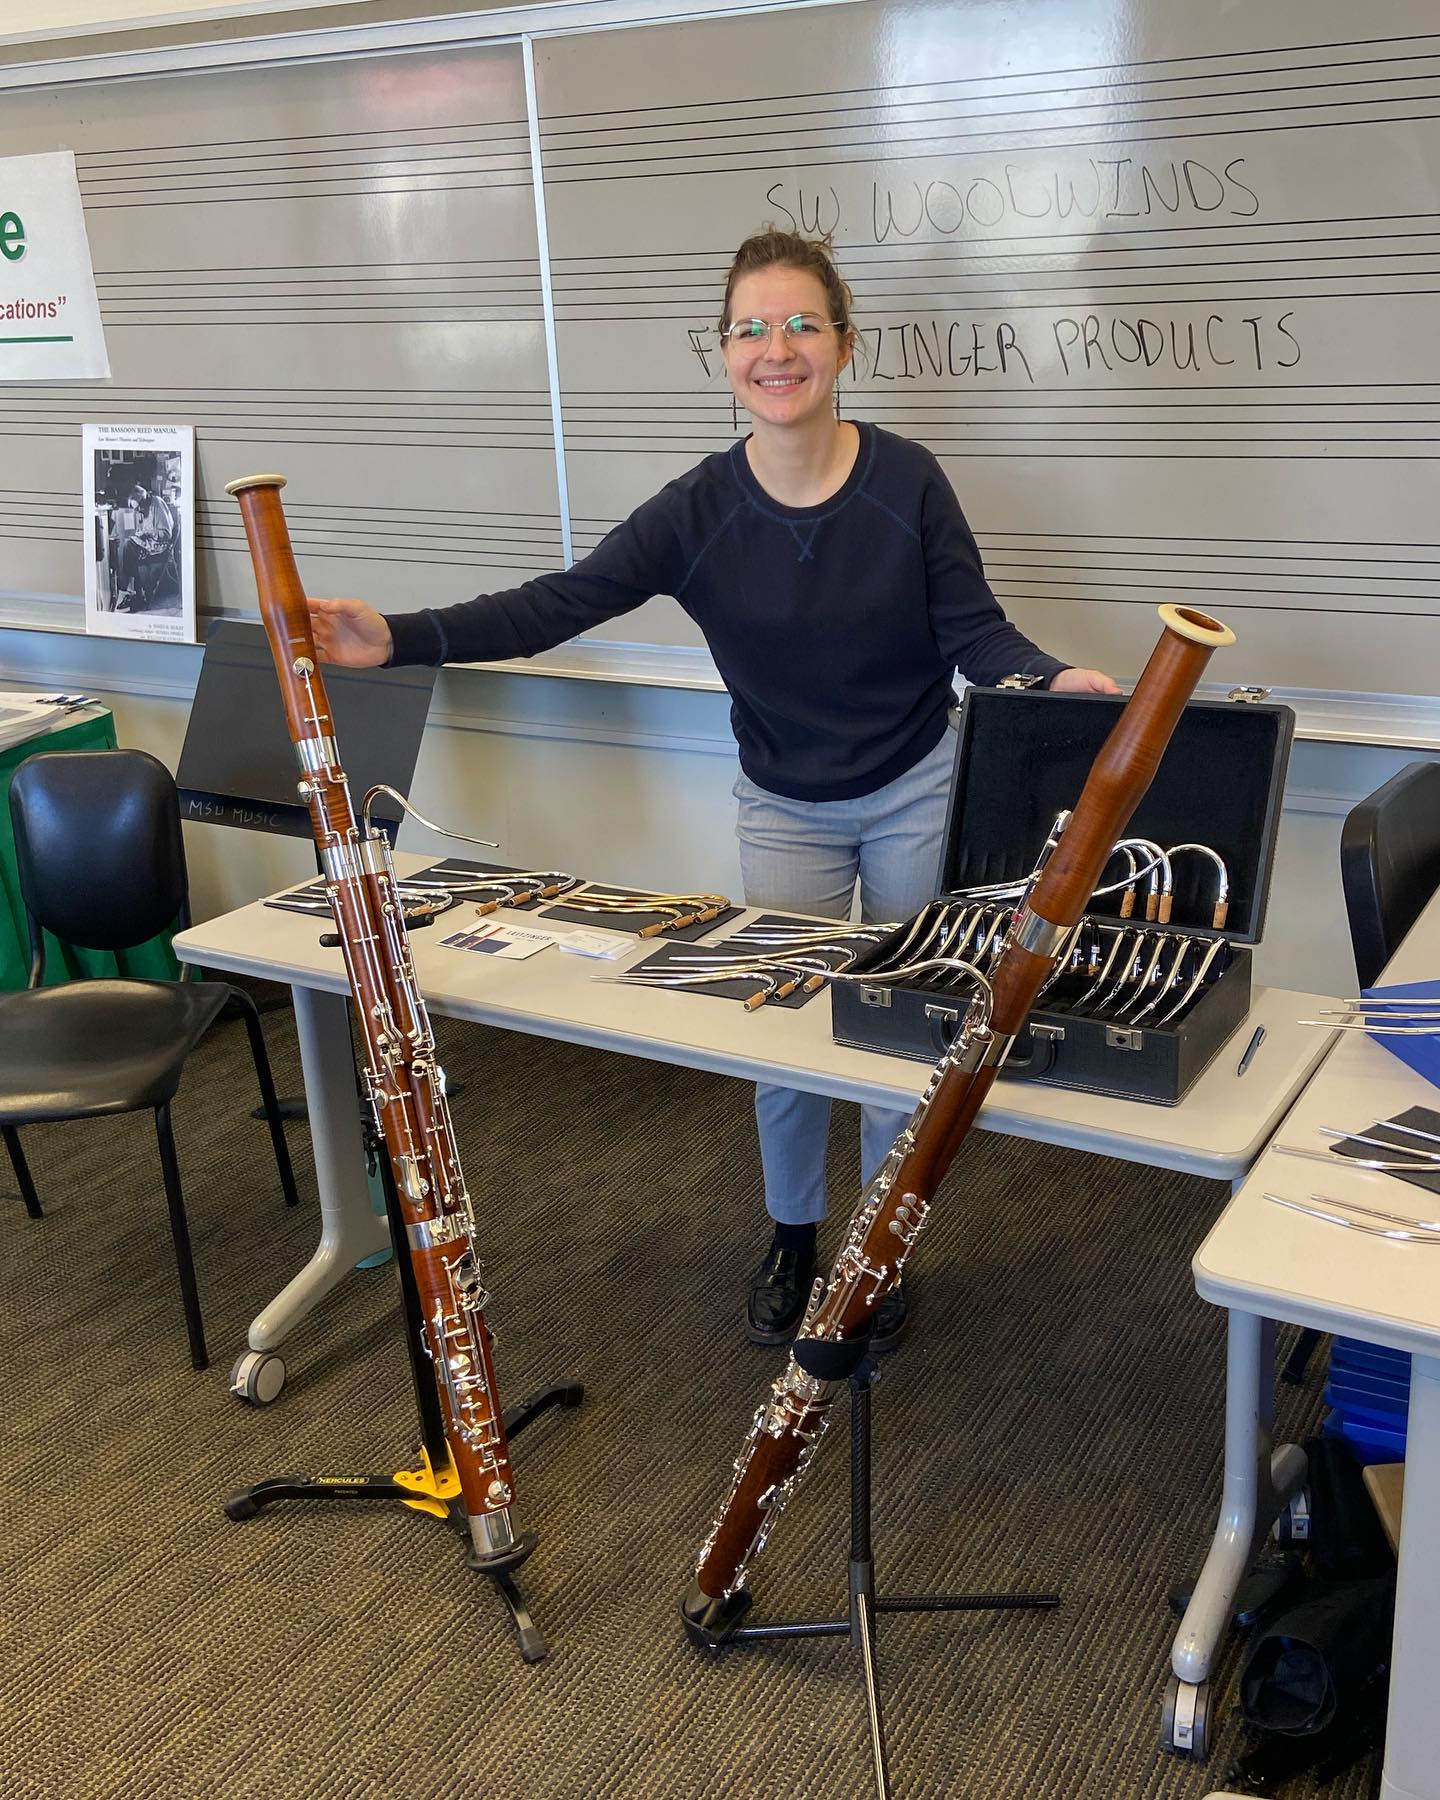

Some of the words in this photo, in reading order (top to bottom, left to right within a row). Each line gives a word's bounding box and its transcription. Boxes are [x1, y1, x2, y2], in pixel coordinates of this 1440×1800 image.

[767, 183, 848, 237] SW.
[873, 158, 1259, 243] WOODWINDS
[1053, 312, 1301, 377] PRODUCTS
[110, 426, 136, 434] BASSOON
[189, 799, 225, 816] MSU
[232, 808, 281, 827] MUSIC
